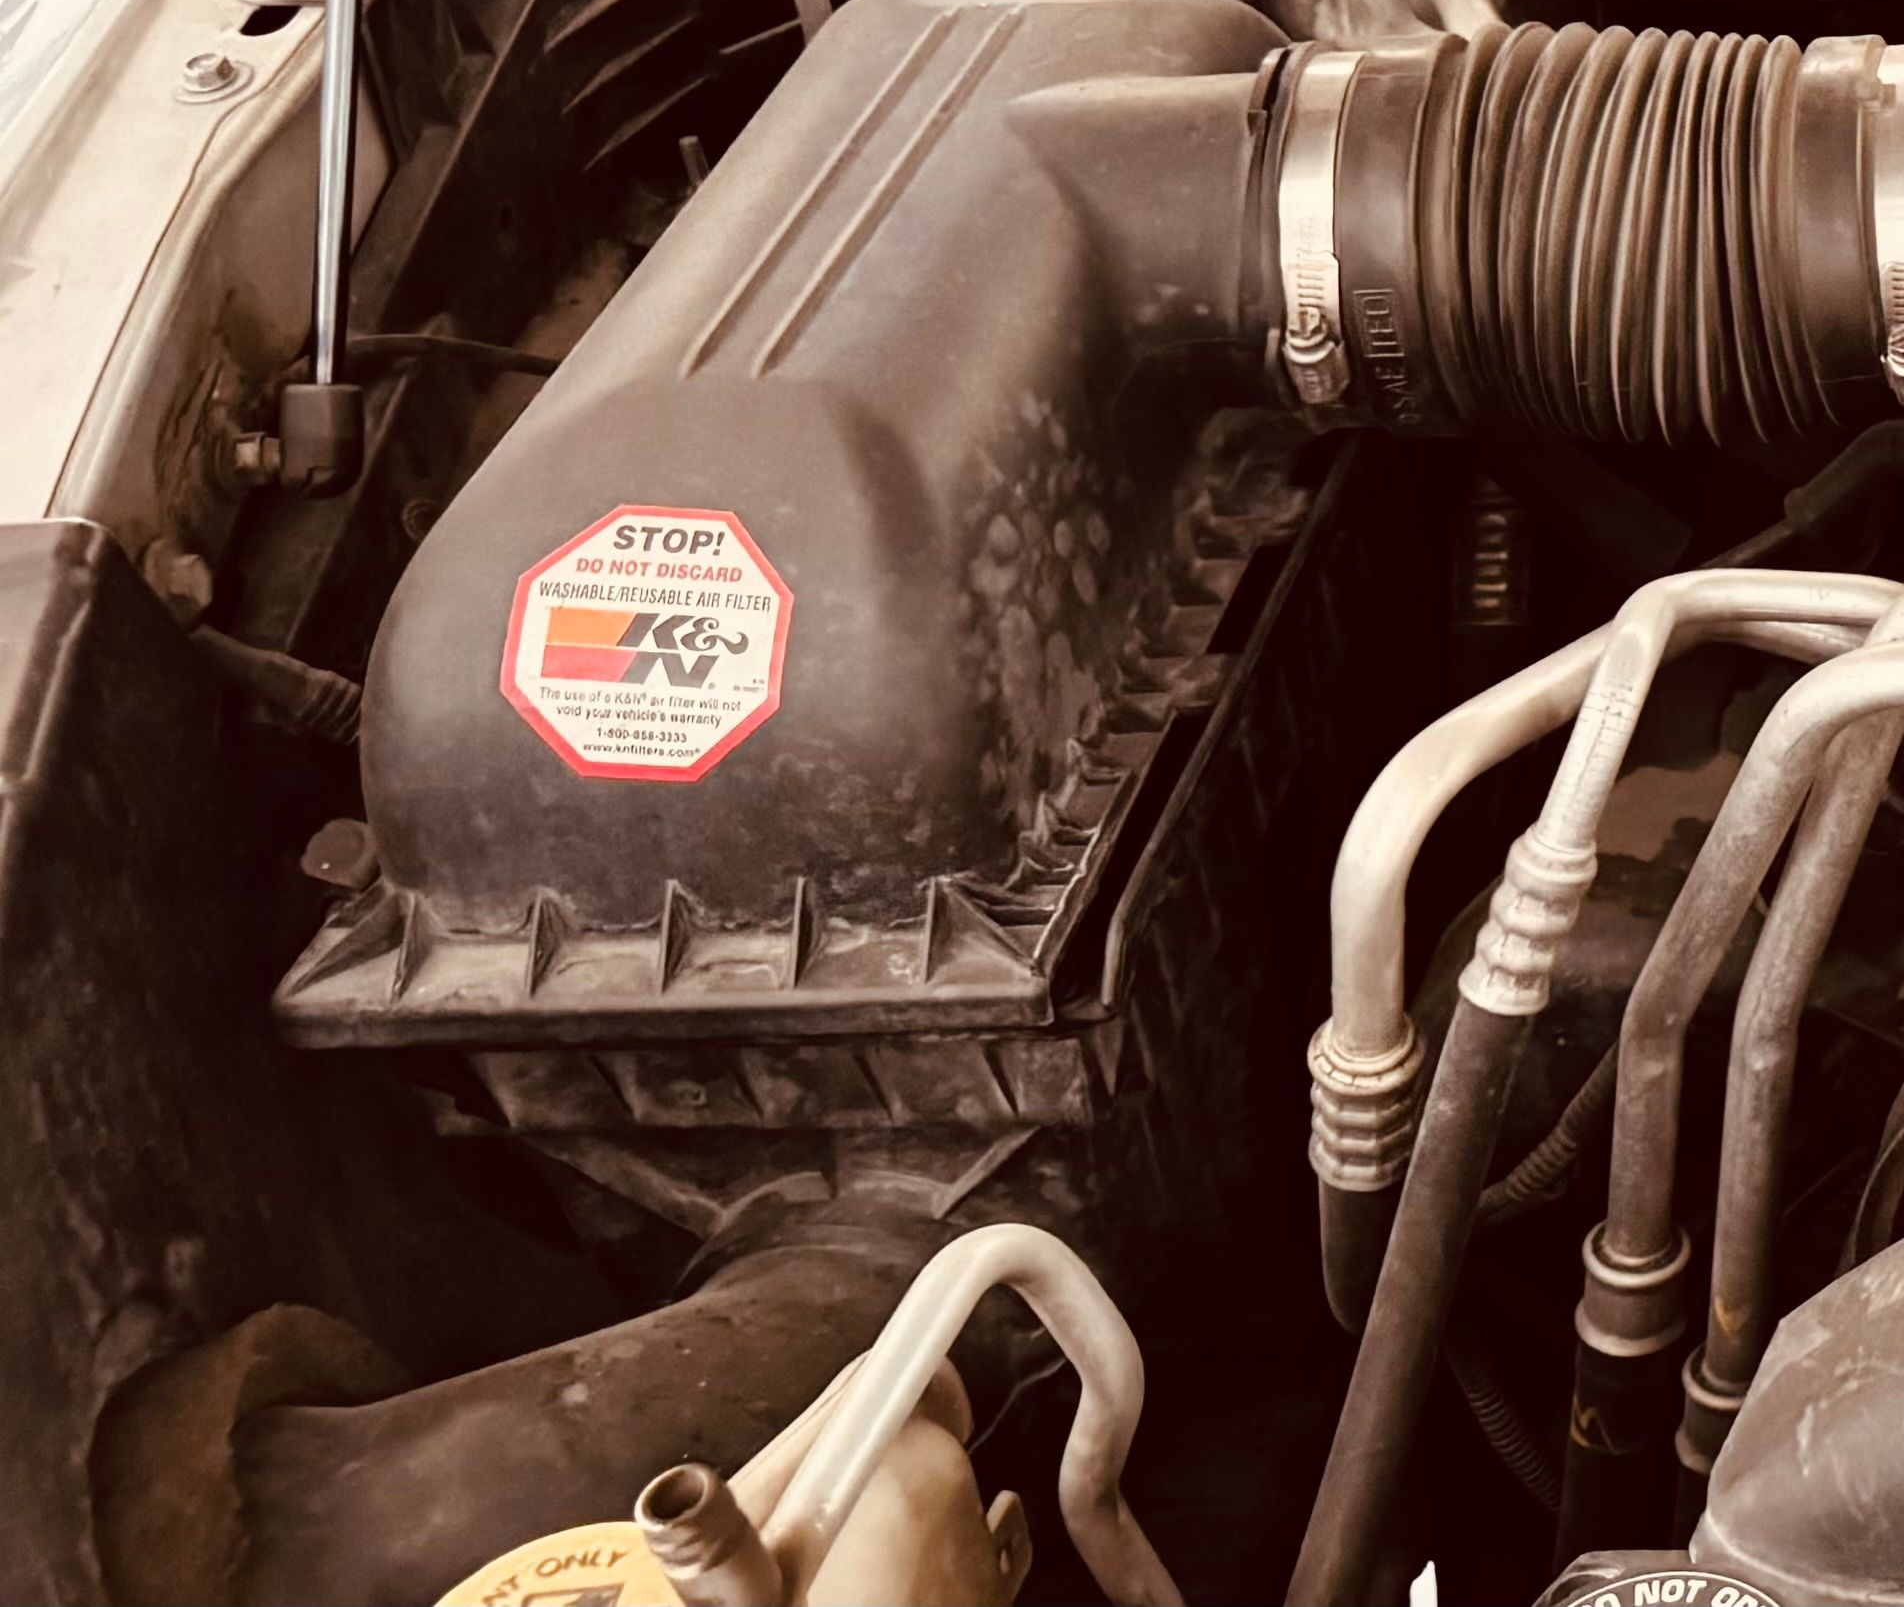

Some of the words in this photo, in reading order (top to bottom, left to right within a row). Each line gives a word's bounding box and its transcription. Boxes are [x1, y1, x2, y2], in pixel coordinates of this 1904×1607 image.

[612, 524, 726, 556] STOP!
[575, 557, 604, 574] DO
[608, 559, 652, 577] NOT
[656, 562, 743, 583] DISCARD
[539, 580, 694, 607] WASHABLE/REUSABLE
[695, 591, 721, 609] AIR
[725, 594, 772, 612] FILTER
[535, 1548, 630, 1578] ONLY
[1633, 1578, 1707, 1607] NOT
